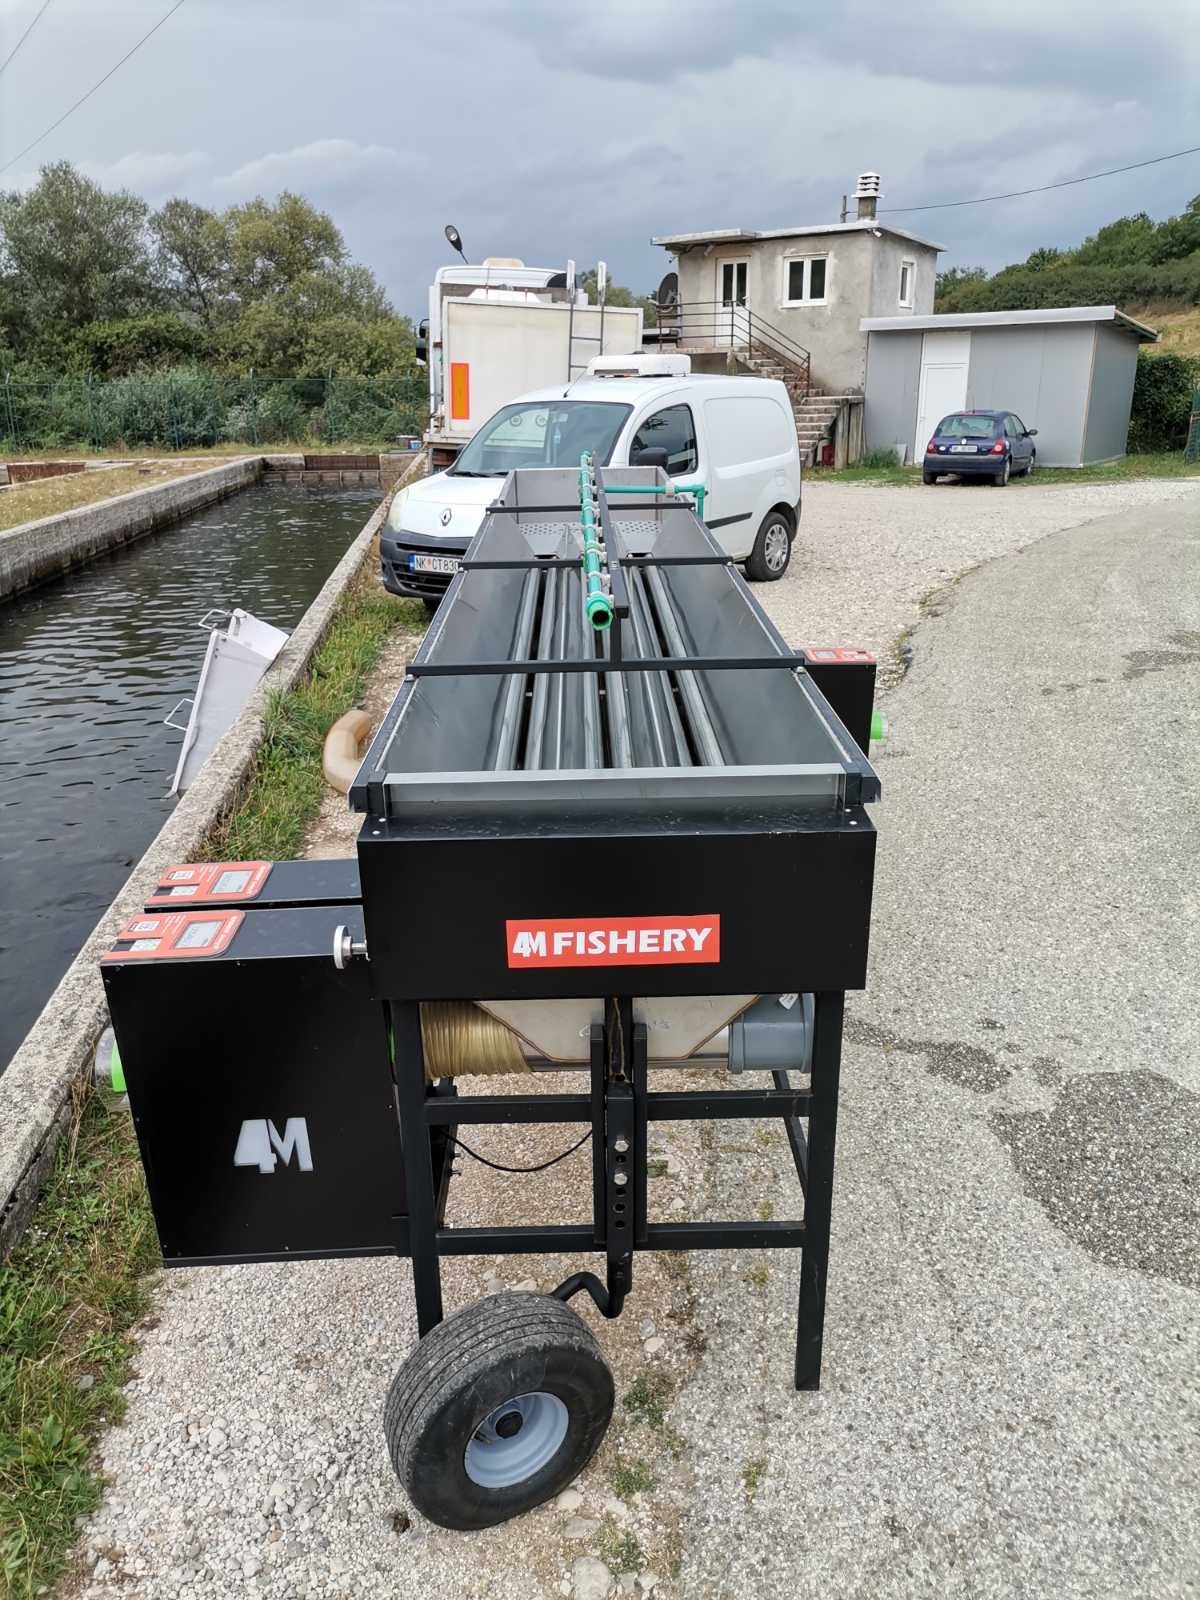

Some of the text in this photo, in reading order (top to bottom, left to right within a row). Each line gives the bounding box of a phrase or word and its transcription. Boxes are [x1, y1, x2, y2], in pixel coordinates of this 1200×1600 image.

[416, 556, 426, 569] NK
[512, 927, 713, 958] 4M FISHERY
[233, 1117, 314, 1174] 4M
